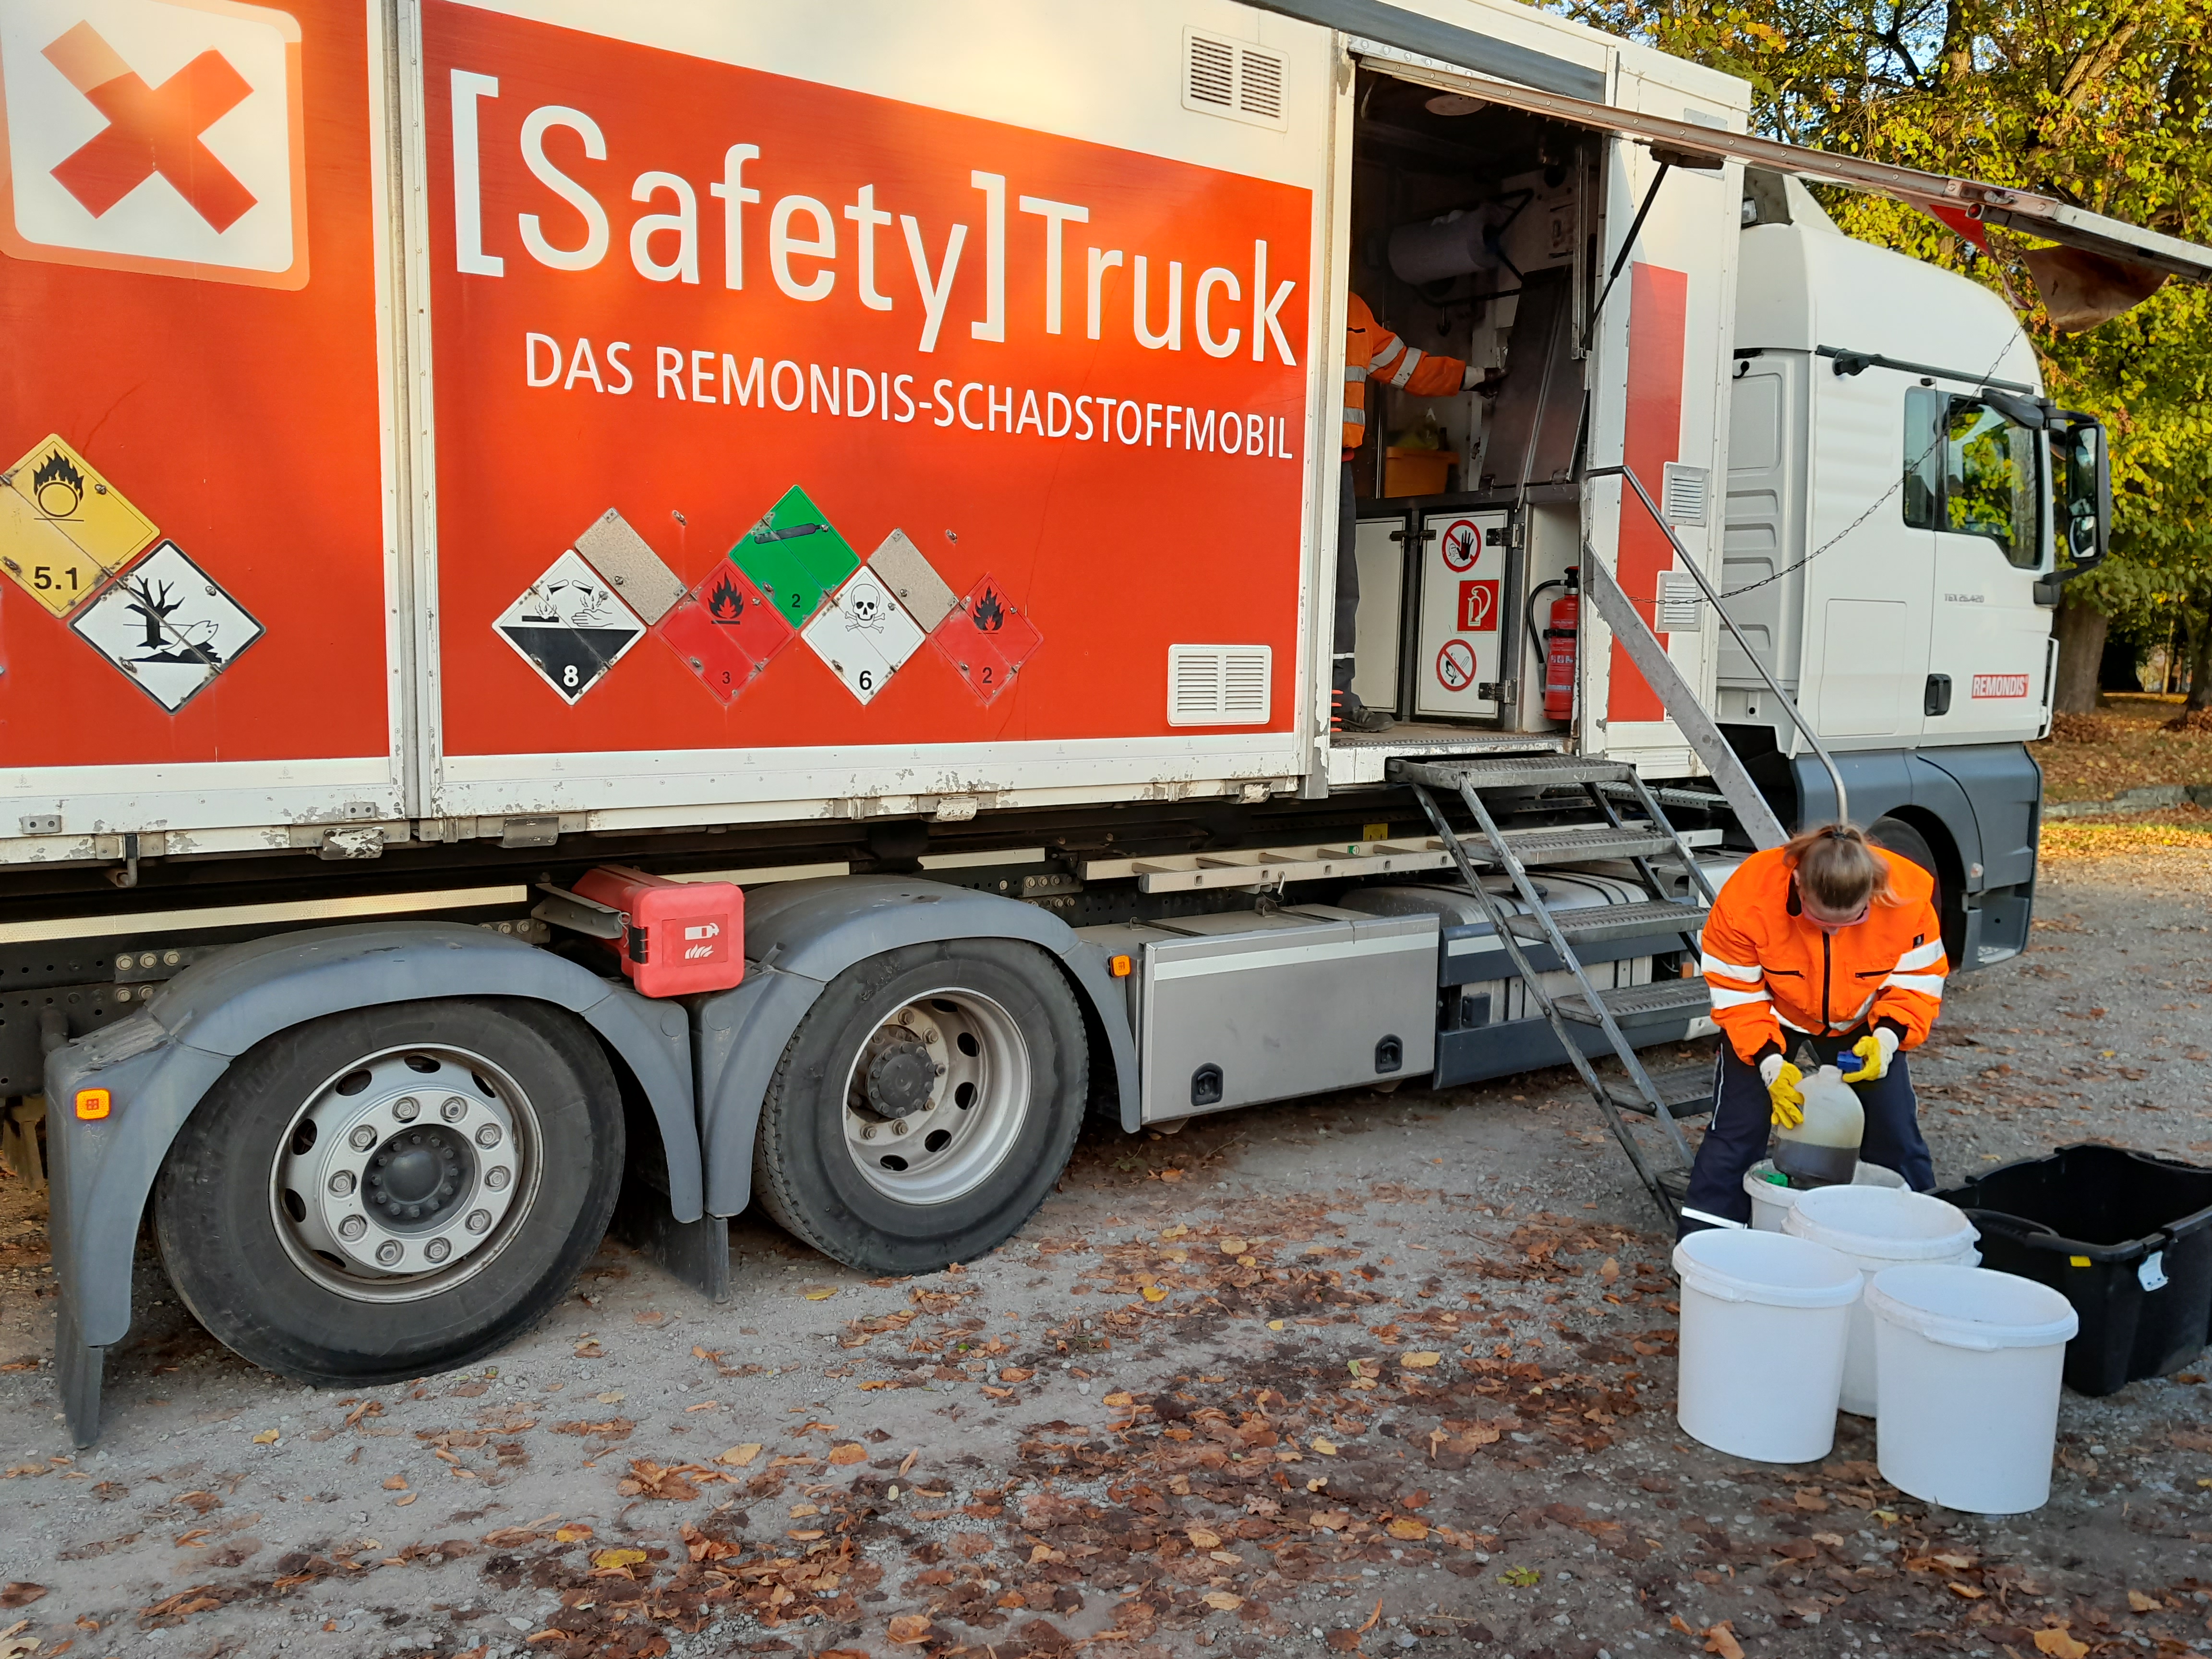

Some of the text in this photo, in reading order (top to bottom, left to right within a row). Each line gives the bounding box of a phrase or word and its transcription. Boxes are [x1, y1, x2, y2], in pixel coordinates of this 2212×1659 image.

[526, 332, 1293, 459] DAS REMONDIS-SCHADSTOFFMOBIL
[35, 566, 78, 590] 5.1
[792, 593, 801, 608] 2
[563, 665, 579, 687] 8
[722, 672, 731, 684] 3
[859, 670, 873, 690] 6
[982, 667, 992, 684] 2
[1972, 675, 2025, 696] REMONDIS
